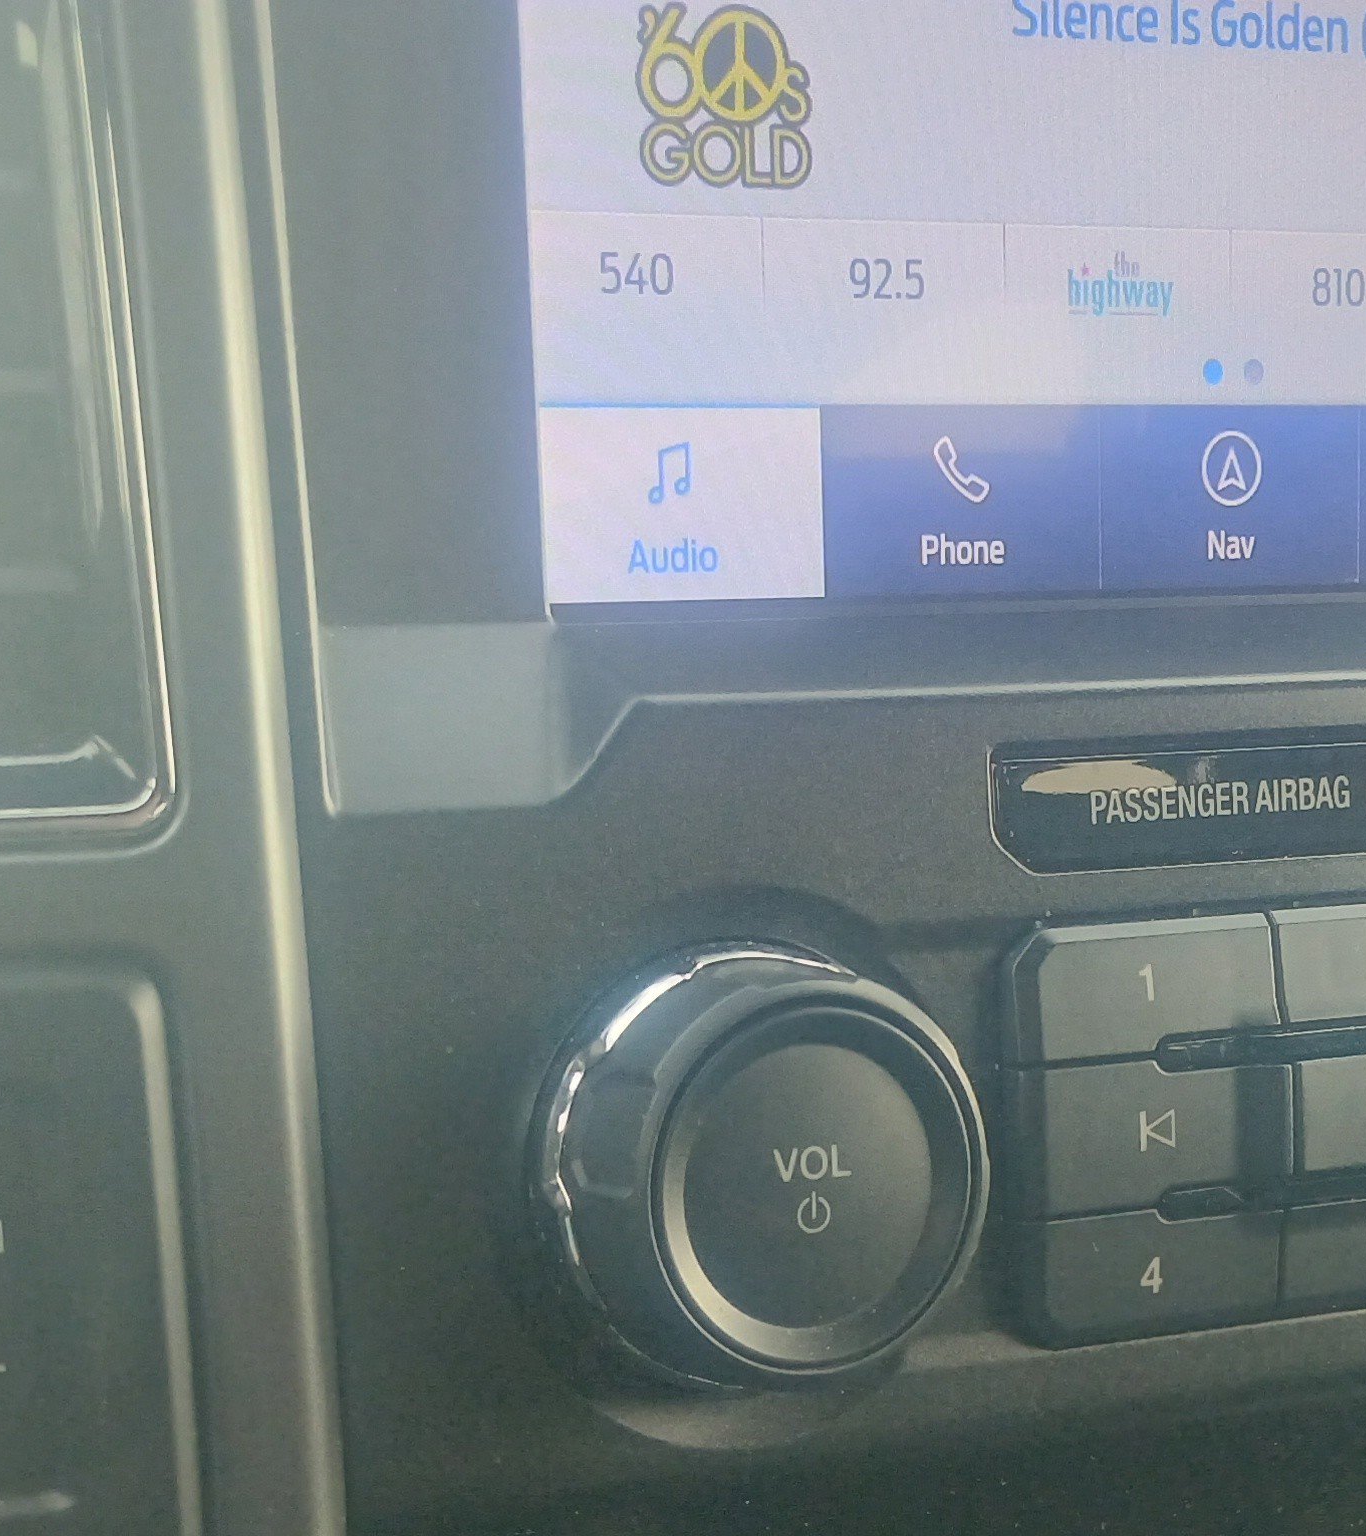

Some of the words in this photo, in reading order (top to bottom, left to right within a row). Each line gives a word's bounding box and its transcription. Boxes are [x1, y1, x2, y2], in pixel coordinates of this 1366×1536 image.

[1011, 0, 1159, 43] Silence
[1170, 0, 1201, 45] Is
[1210, 0, 1349, 55] Golden
[640, 120, 812, 189] GOLD
[598, 251, 675, 295] 540
[848, 257, 926, 300] 92.5
[1067, 268, 1175, 317] highway
[1311, 267, 1366, 308] 810
[627, 537, 720, 575] Audio
[919, 533, 1006, 567] Phone
[1206, 529, 1257, 561] Nav
[1089, 782, 1250, 826] PASSENGER
[1253, 774, 1352, 815] AIRBAG
[1138, 963, 1157, 1002] 1
[772, 1143, 853, 1184] VOL
[1140, 1255, 1164, 1296] 4
